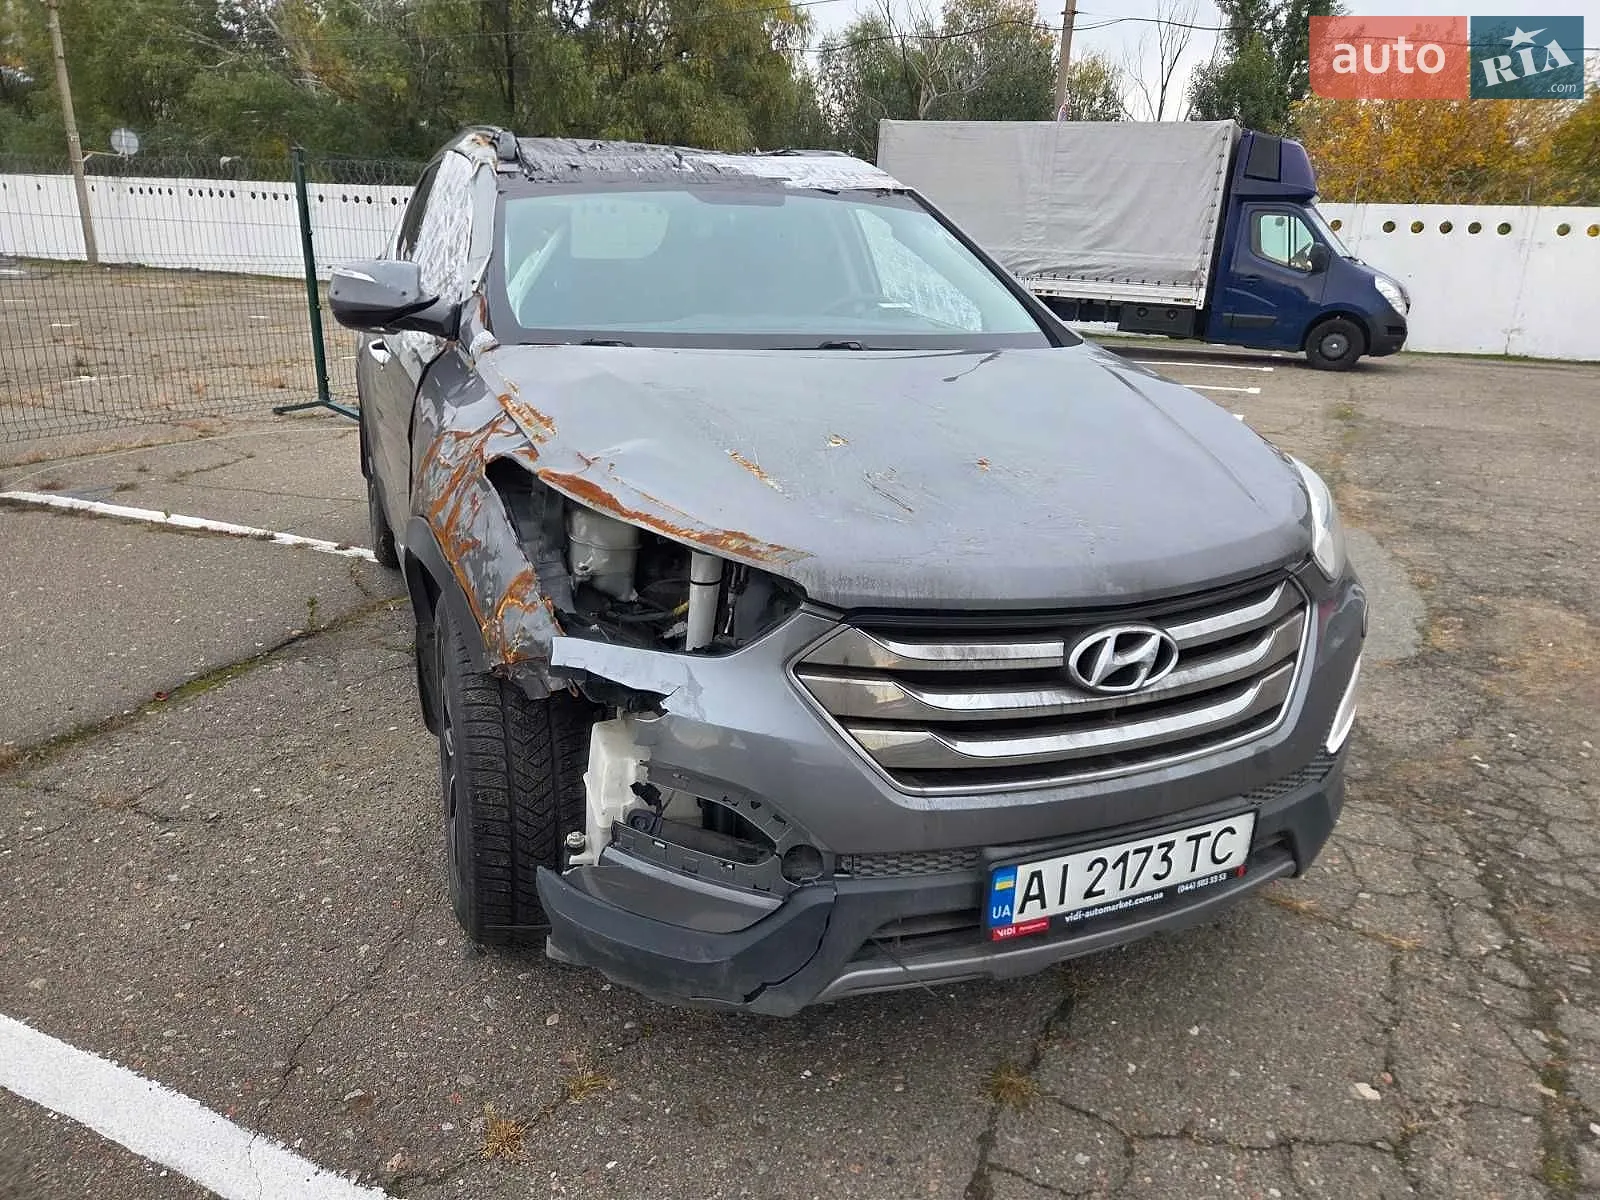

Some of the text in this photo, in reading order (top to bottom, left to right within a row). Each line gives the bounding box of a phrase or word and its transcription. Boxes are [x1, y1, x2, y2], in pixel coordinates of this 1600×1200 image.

[1017, 826, 1238, 914] AI 2173 TC
[992, 903, 1012, 919] UA
